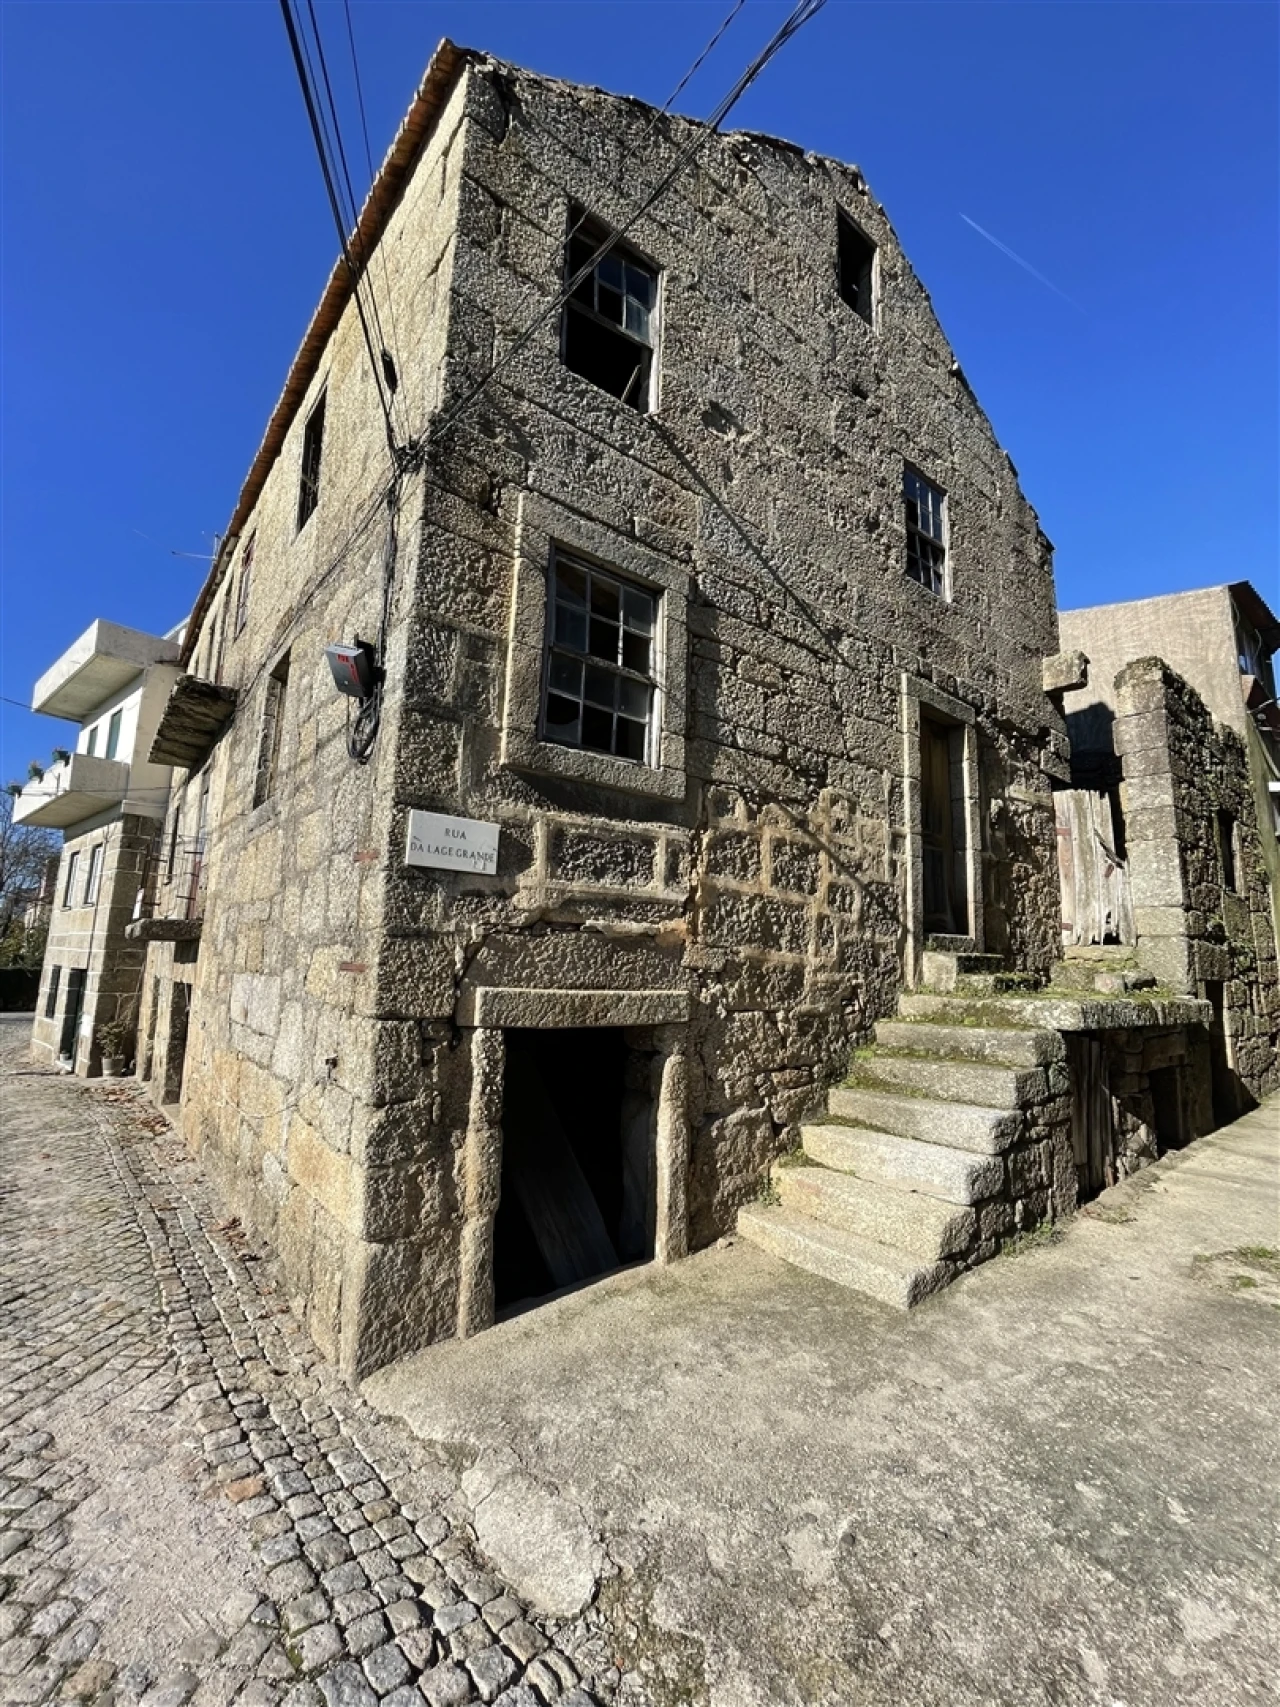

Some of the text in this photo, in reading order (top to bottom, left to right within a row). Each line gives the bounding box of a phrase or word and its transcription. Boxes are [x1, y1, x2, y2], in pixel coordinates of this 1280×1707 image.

[444, 828, 467, 840] RUA
[410, 842, 495, 862] DA LAGE GRANDE
